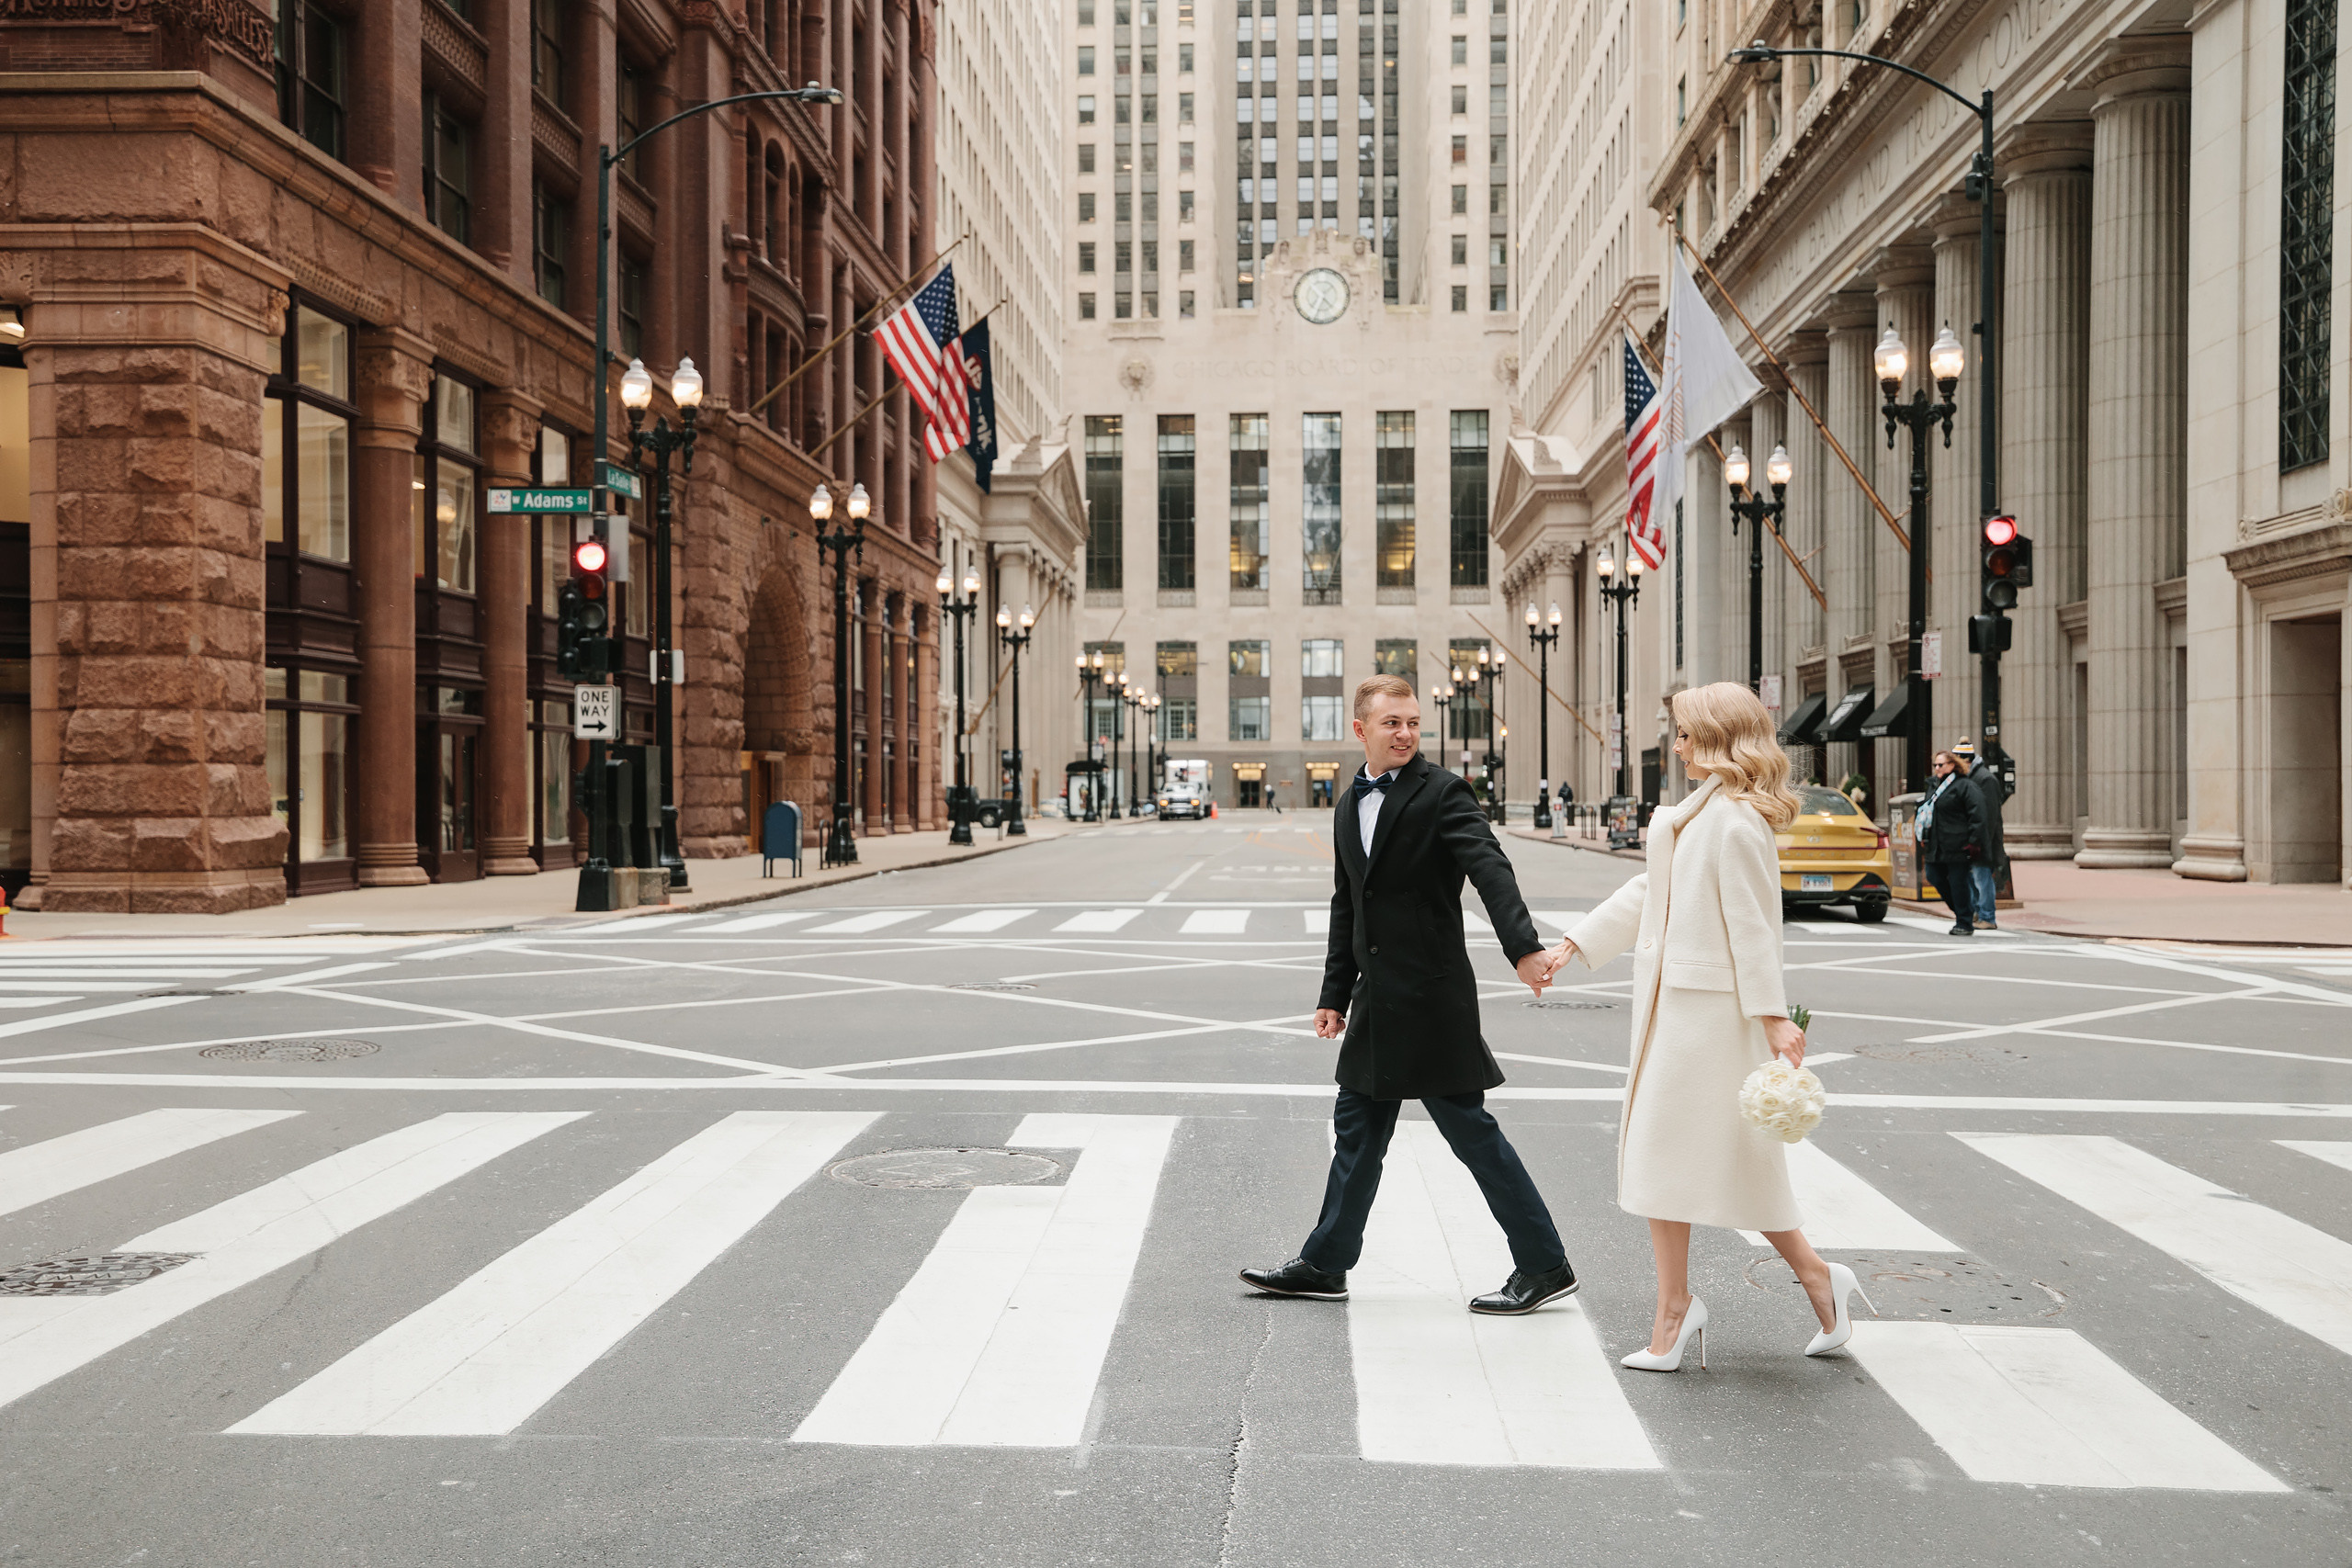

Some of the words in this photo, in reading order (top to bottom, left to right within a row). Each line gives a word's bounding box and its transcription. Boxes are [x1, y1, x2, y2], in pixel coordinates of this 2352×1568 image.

[1856, 143, 1890, 217] AND
[1903, 62, 1962, 164] TRUST
[1172, 359, 1276, 379] CHICAGO
[1285, 357, 1358, 377] BOARD
[1369, 356, 1397, 375] OF
[1408, 355, 1476, 375] TRADE
[512, 495, 521, 504] W
[523, 492, 573, 508] Adams
[577, 496, 588, 505] St
[581, 691, 609, 703] ONE
[581, 705, 609, 716] WAY
